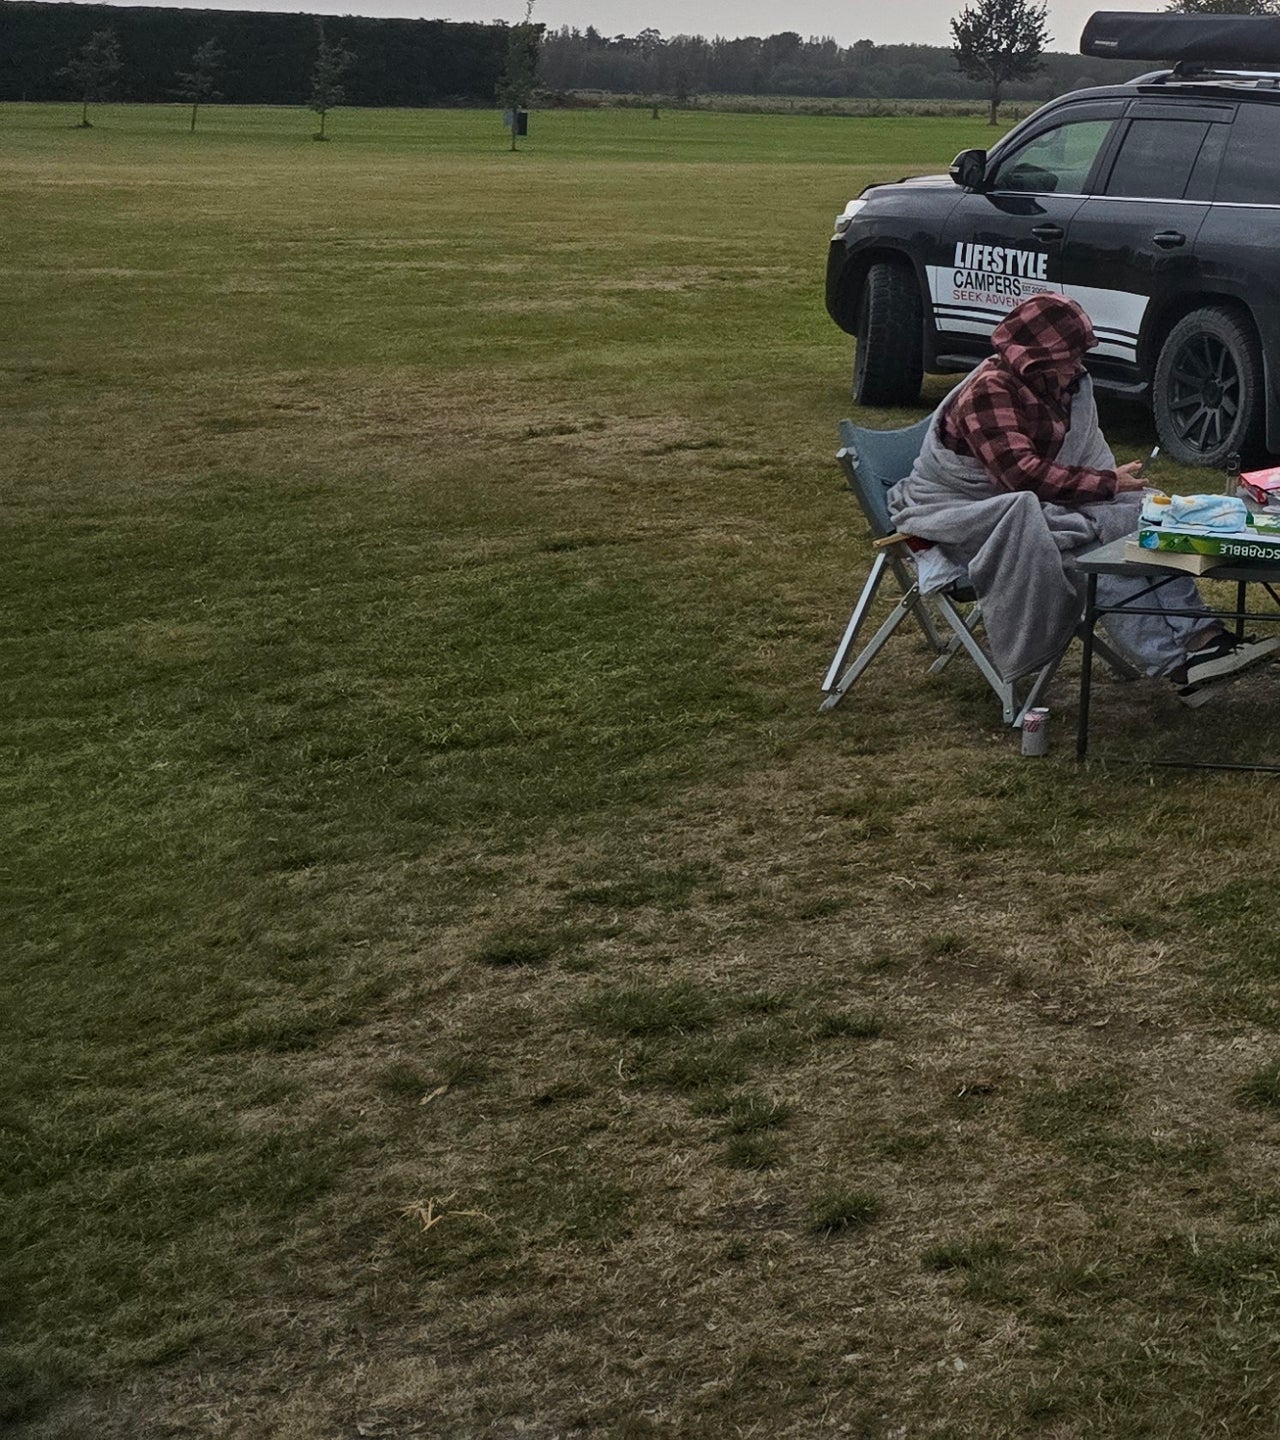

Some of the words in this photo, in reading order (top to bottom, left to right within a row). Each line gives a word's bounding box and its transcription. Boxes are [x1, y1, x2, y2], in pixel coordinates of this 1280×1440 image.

[953, 241, 1049, 280] LIFESTYLE
[952, 289, 982, 303] SEEK
[953, 270, 1021, 297] CAMPERS
